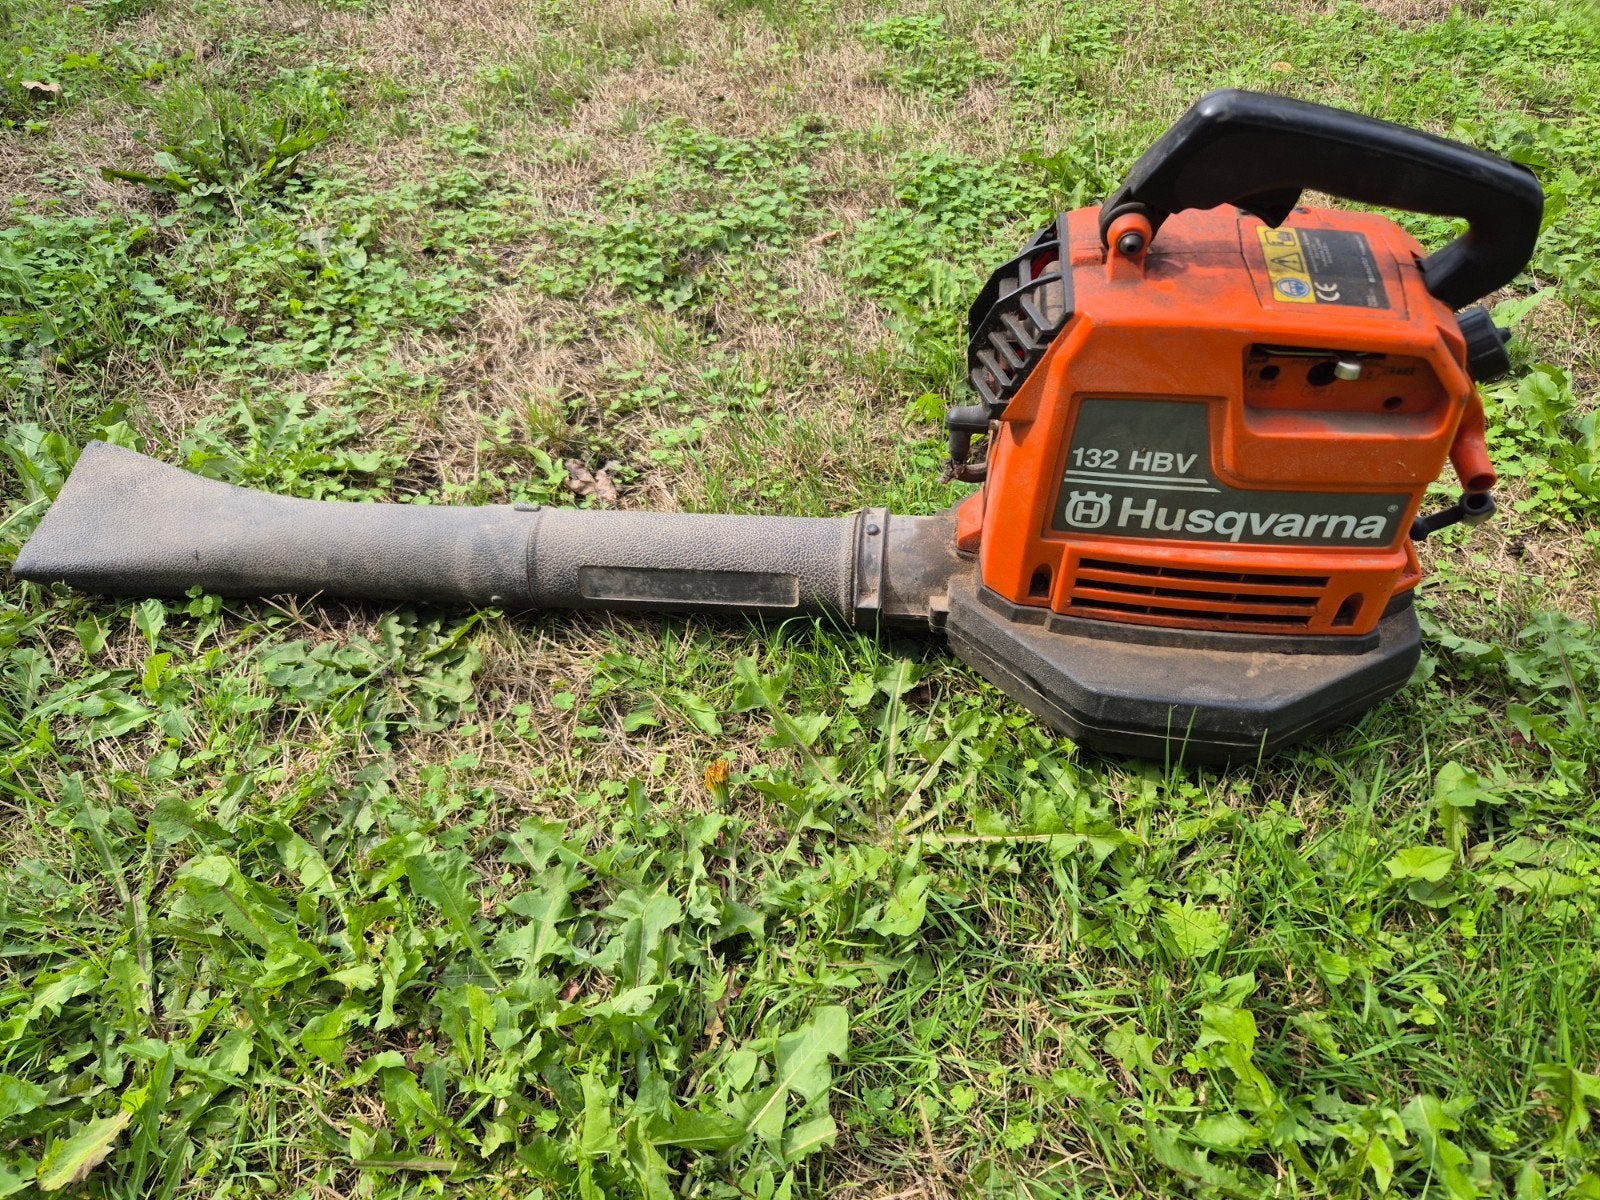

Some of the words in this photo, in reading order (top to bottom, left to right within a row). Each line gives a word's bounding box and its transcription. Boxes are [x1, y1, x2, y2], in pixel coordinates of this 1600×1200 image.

[1314, 281, 1341, 302] CE
[1072, 447, 1119, 470] 132
[1129, 450, 1198, 475] HBV
[1117, 497, 1388, 542] Husqvarna
